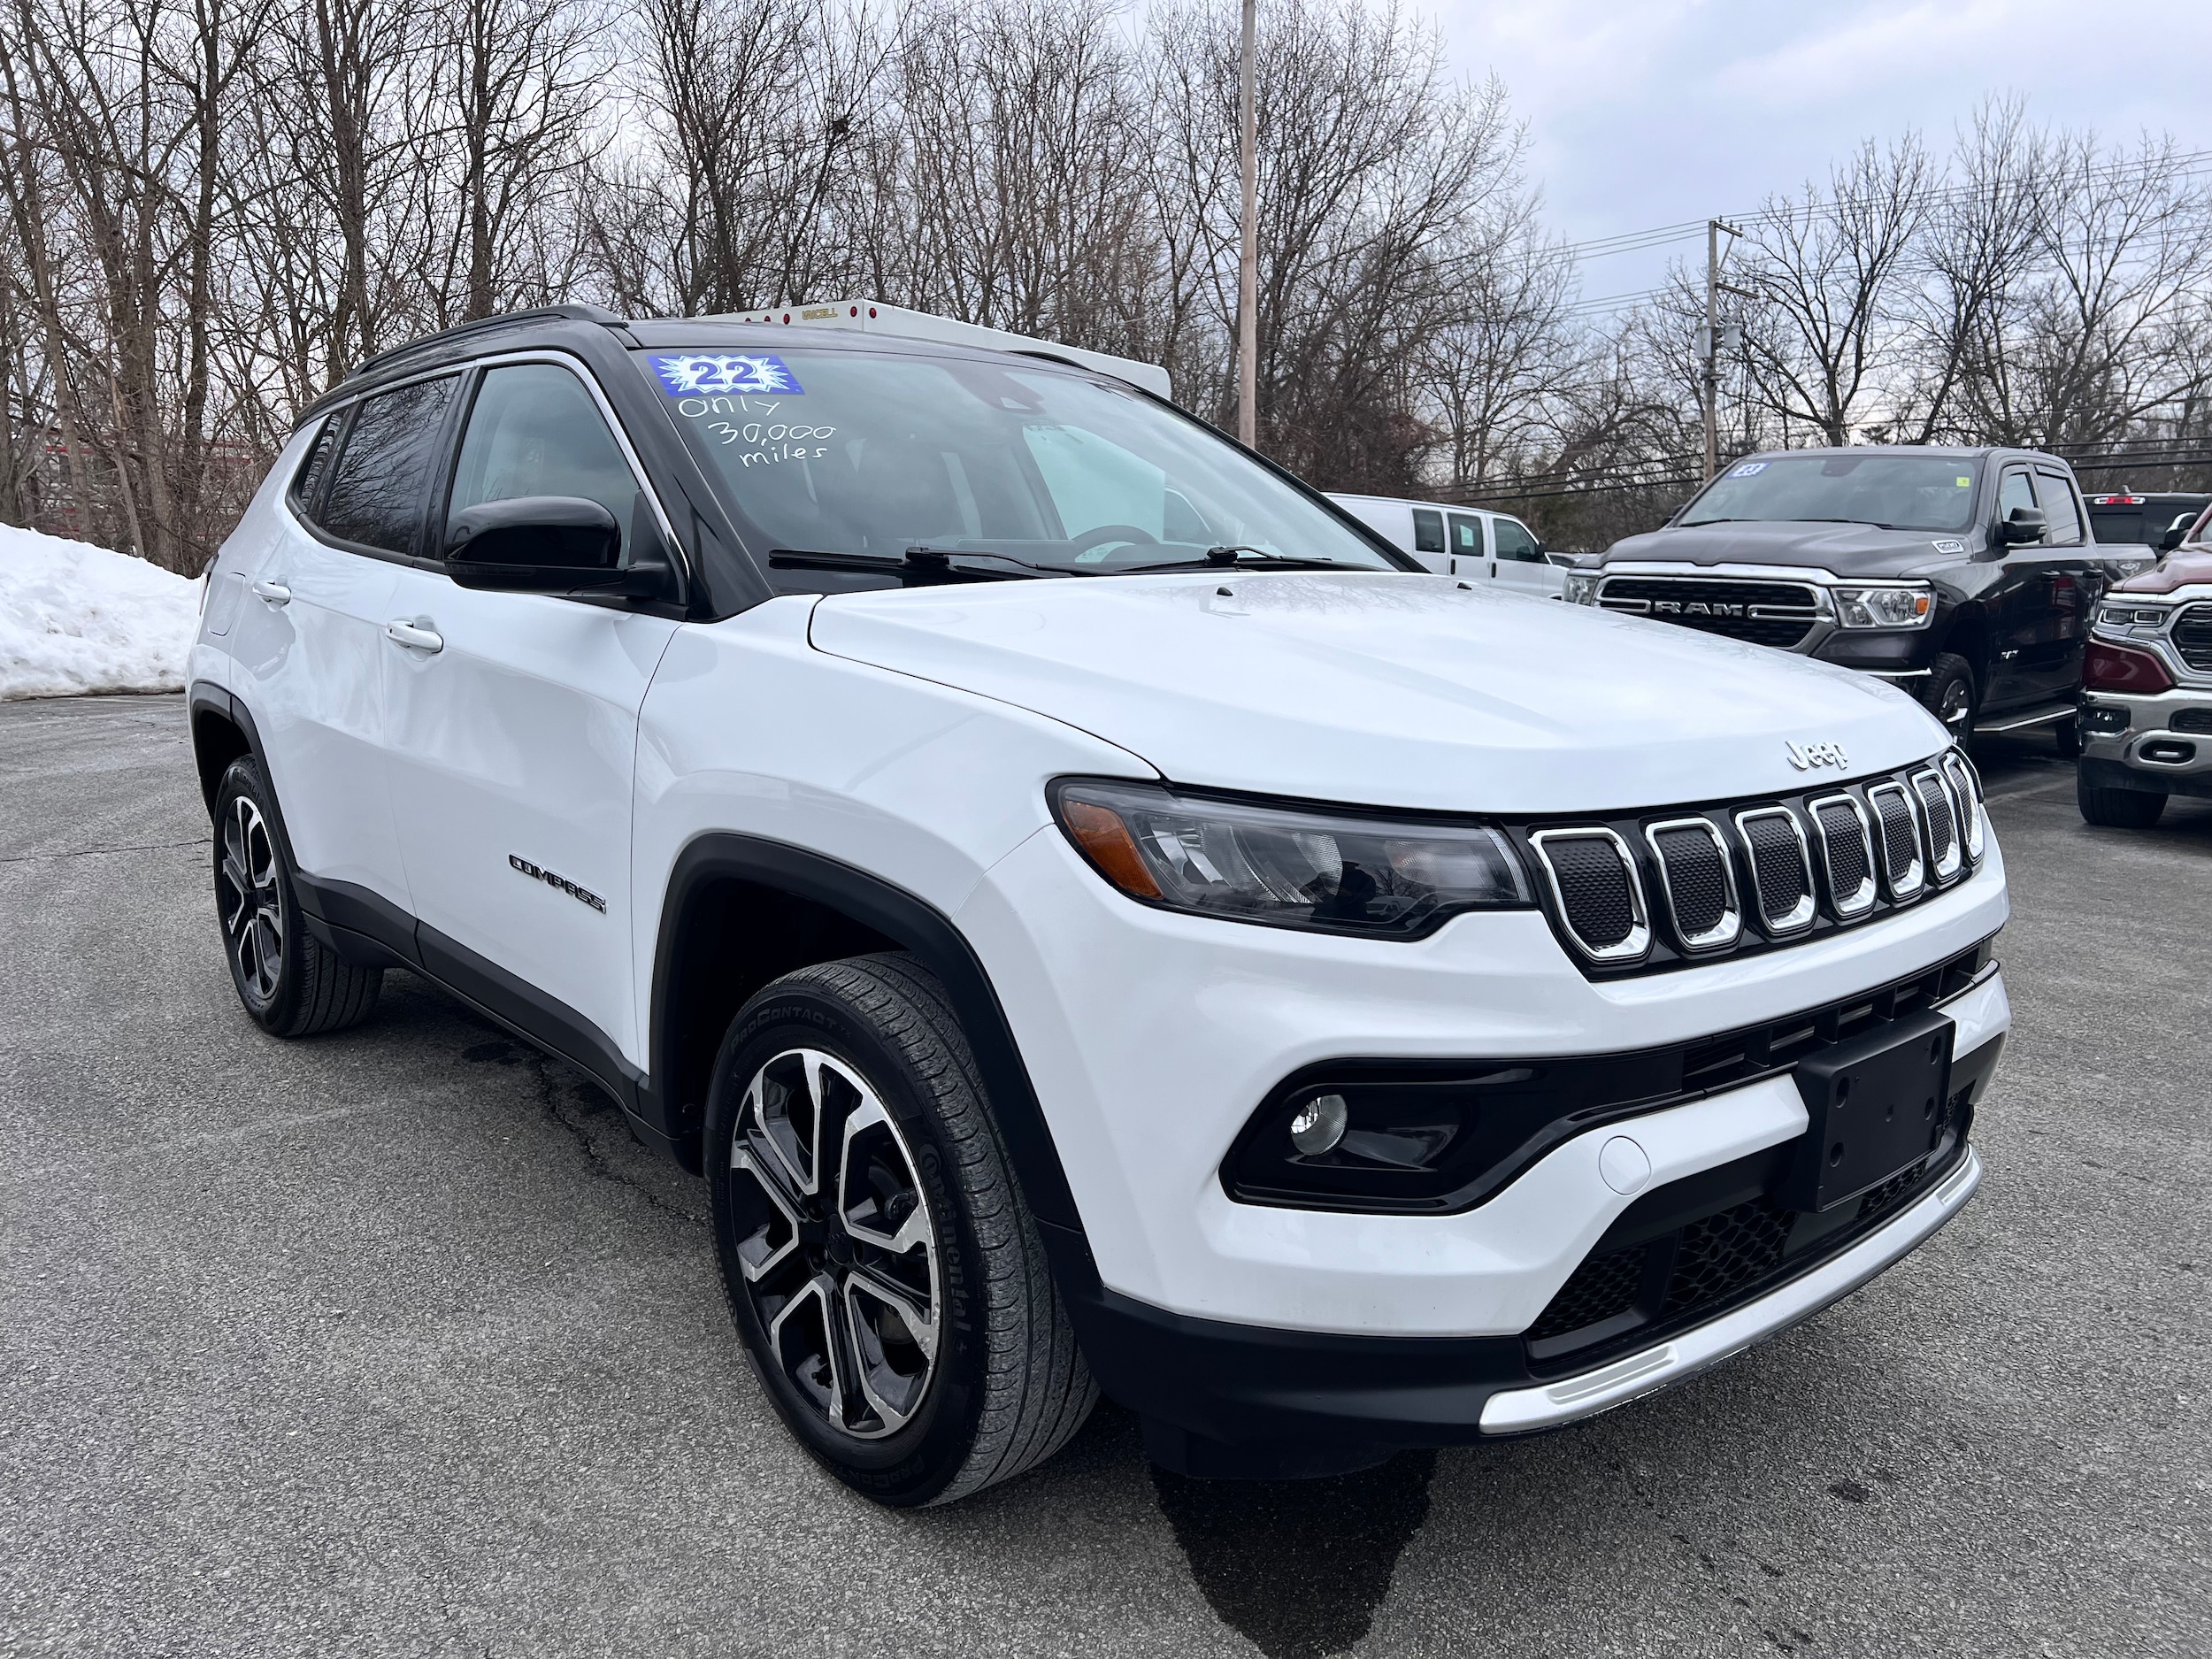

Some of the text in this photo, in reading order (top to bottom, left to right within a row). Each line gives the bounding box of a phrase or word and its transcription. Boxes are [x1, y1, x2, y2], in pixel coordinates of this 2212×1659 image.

[689, 361, 762, 385] 22
[707, 422, 837, 446] 30,000
[740, 443, 828, 468] miles
[1655, 601, 1743, 617] RAM
[1785, 740, 1848, 772] Jeep
[509, 853, 607, 914] COMPASS
[919, 1143, 972, 1332] Continental
